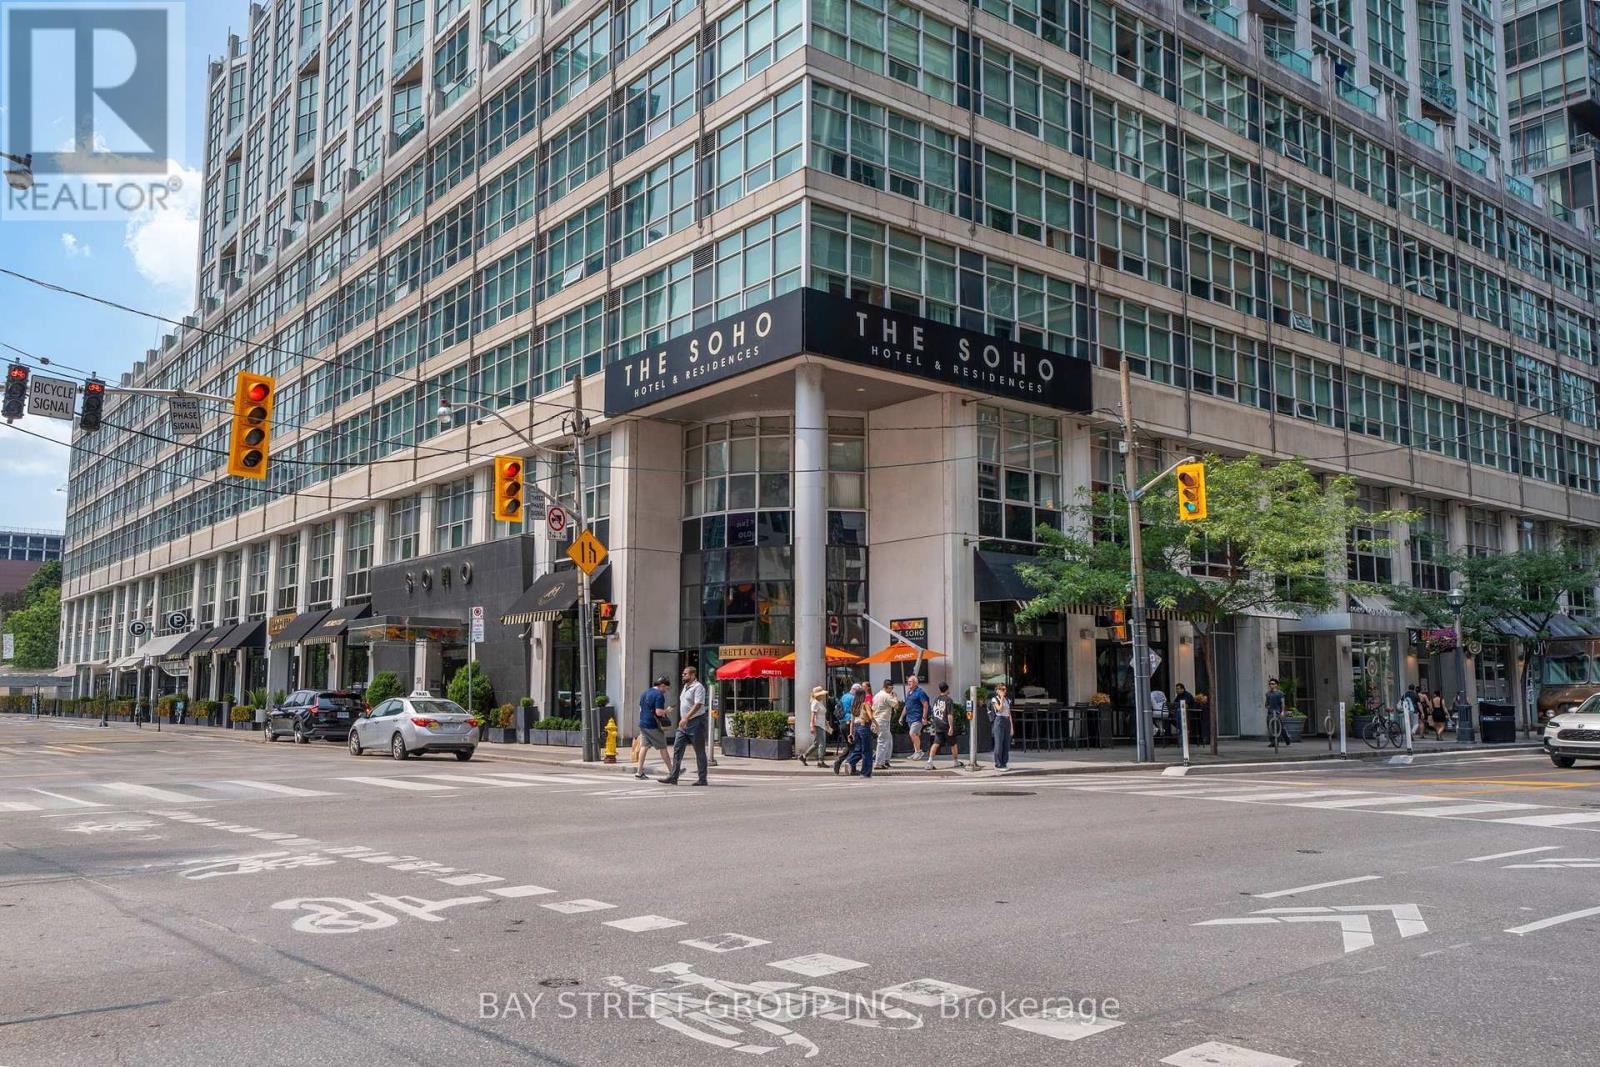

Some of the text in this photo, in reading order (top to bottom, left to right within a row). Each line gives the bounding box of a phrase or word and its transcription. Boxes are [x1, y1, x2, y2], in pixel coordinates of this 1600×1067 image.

[624, 311, 772, 387] THE SOHO
[855, 311, 1055, 381] THE SOHO
[634, 346, 760, 398] HOTEL & RESIDENCES
[871, 345, 1043, 393] HOTEL & RESIDENCES
[33, 381, 75, 399] BICYCLE
[33, 397, 70, 414] SIGNAL
[172, 401, 197, 409] THREE
[172, 411, 198, 420] PHASE
[173, 422, 200, 430] SIGNAL
[905, 629, 925, 637] SOHO
